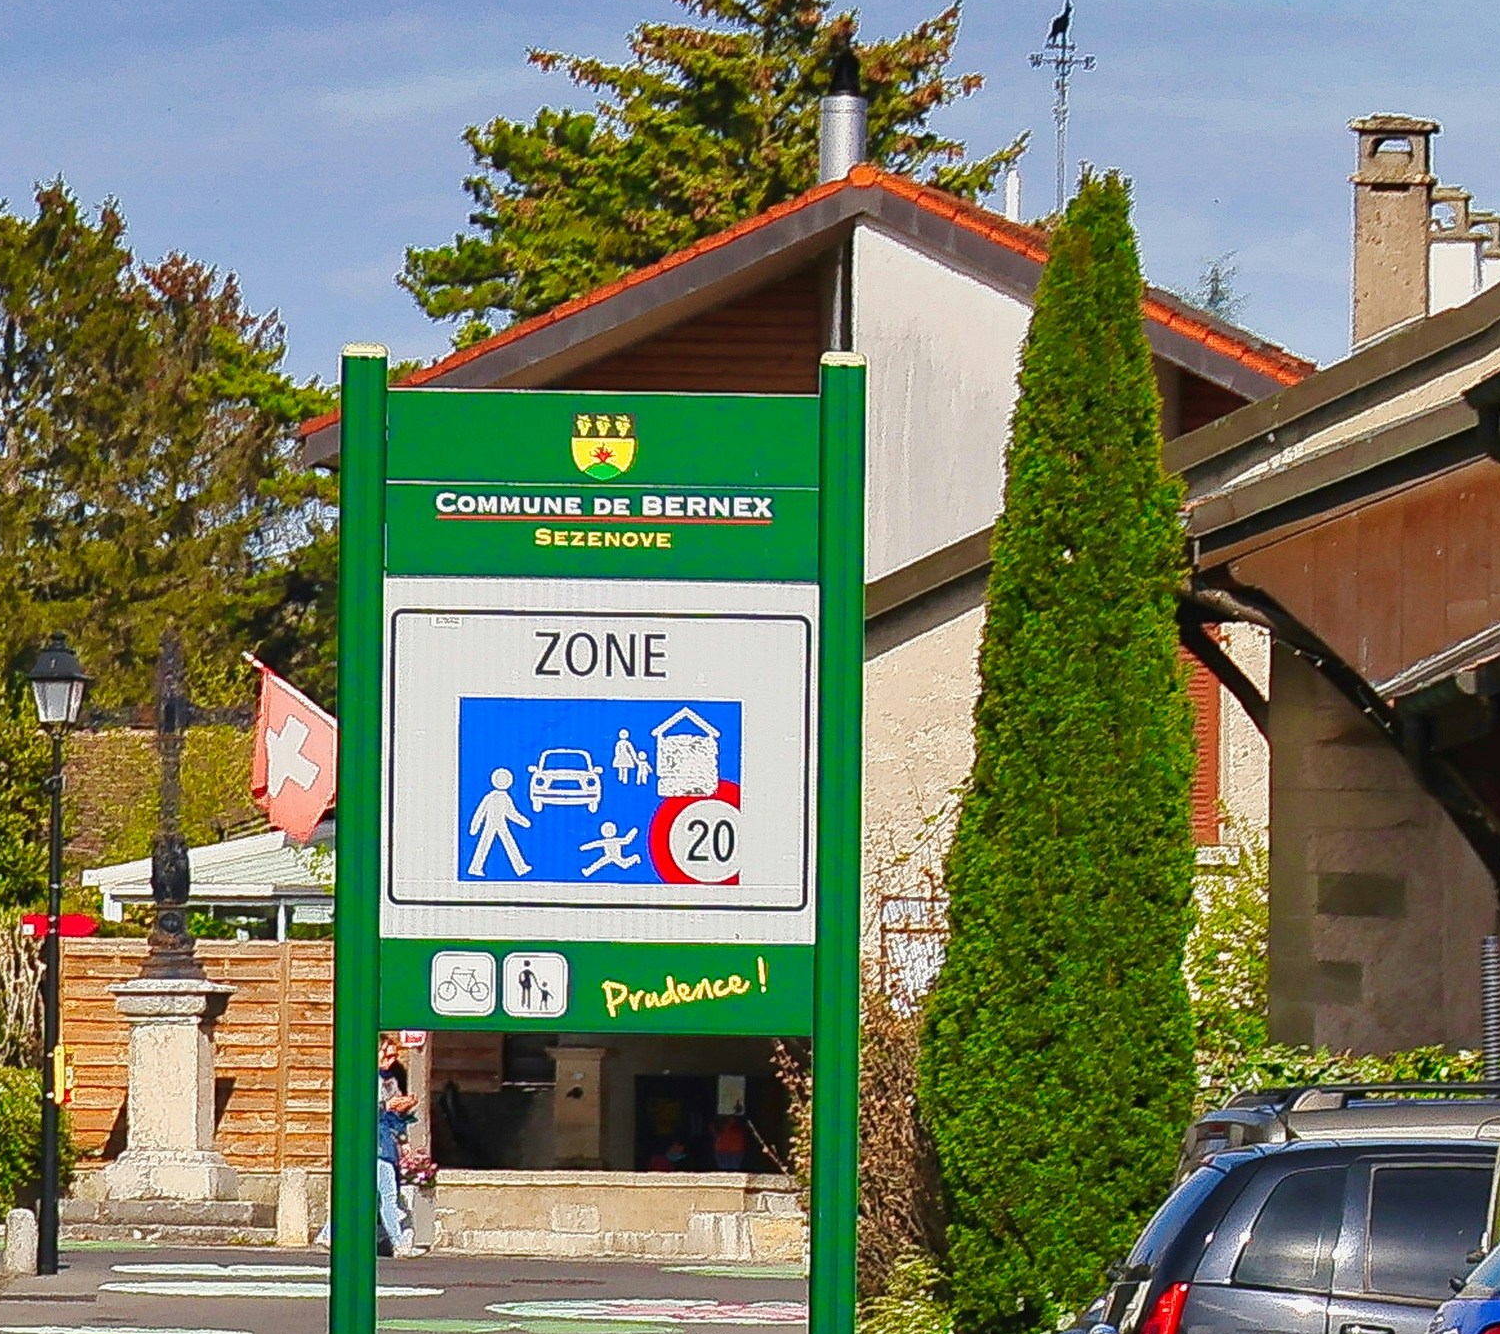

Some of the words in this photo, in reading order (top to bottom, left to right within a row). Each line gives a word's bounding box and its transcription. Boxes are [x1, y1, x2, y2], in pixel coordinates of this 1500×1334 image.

[435, 492, 582, 515] COMMUNE
[593, 497, 631, 516] DE
[641, 495, 773, 518] BERNEX
[535, 528, 672, 548] SEZENOVE
[535, 631, 667, 678] ZONE
[686, 819, 735, 863] 20
